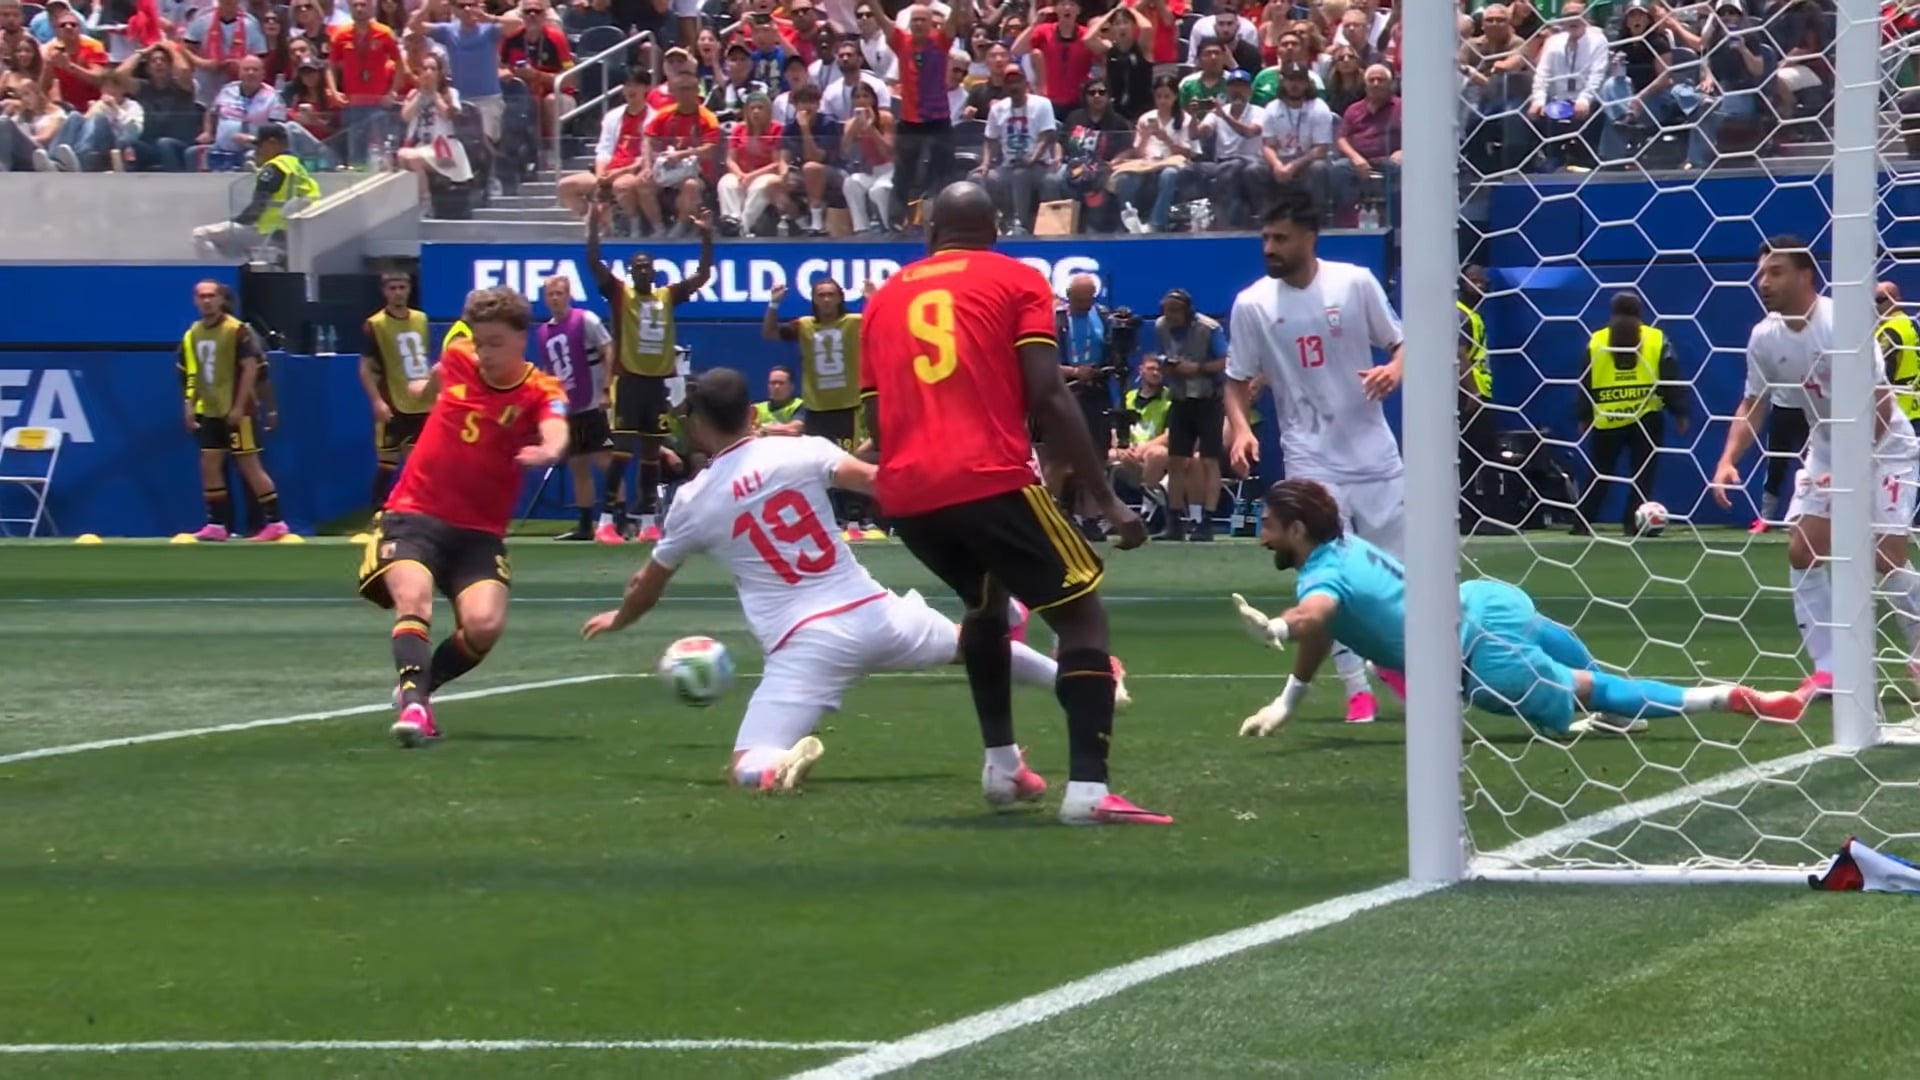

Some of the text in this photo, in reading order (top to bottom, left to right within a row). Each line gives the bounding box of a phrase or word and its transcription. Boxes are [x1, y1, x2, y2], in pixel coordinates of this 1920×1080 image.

[474, 259, 587, 302] FIFA
[796, 258, 902, 302] CUP
[907, 289, 957, 385] 9
[1296, 335, 1325, 368] 13
[732, 470, 764, 501] ALI
[732, 488, 836, 585] 19
